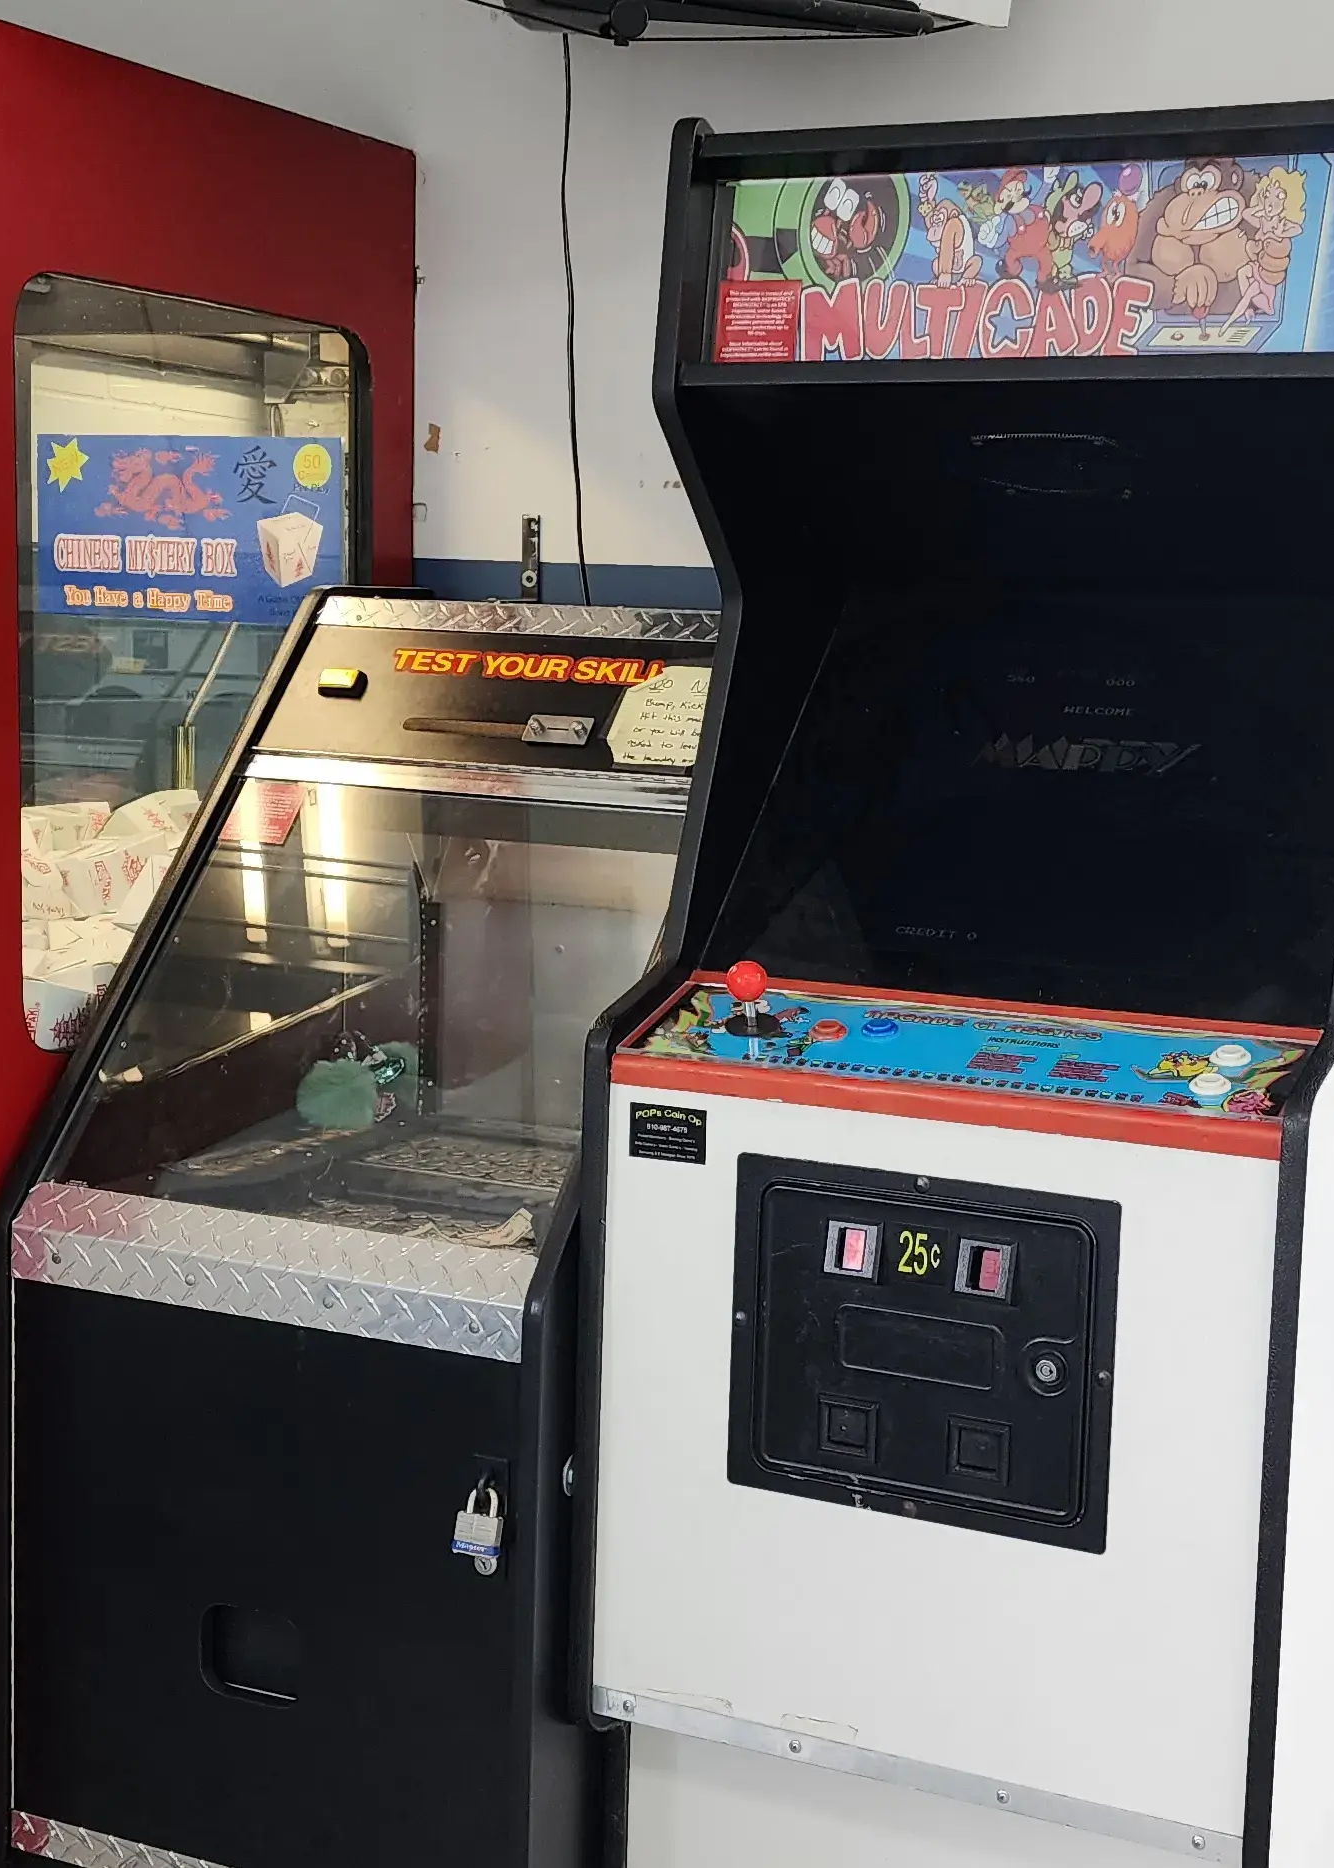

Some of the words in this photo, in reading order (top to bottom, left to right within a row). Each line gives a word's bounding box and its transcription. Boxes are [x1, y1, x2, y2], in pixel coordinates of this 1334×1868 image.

[802, 281, 1154, 361] MULTICADE
[303, 454, 321, 469] 50
[233, 445, 278, 505] 愛
[56, 537, 121, 572] CHINESE
[203, 540, 236, 575] BOX
[65, 585, 90, 606] You
[95, 586, 128, 608] Have
[133, 593, 143, 607] a
[148, 587, 190, 611] Happy
[196, 590, 233, 611] Time
[396, 649, 478, 673] TEST
[484, 654, 573, 681] YOUR
[1062, 705, 1136, 717] WELCOME
[650, 728, 665, 736] you
[670, 729, 685, 737] will
[661, 741, 674, 749] to
[623, 752, 636, 760] the
[895, 925, 957, 940] CREDIT
[967, 931, 977, 941] 0
[664, 1109, 687, 1121] Coin
[687, 1114, 703, 1126] Op
[897, 1230, 941, 1276] 25¢
